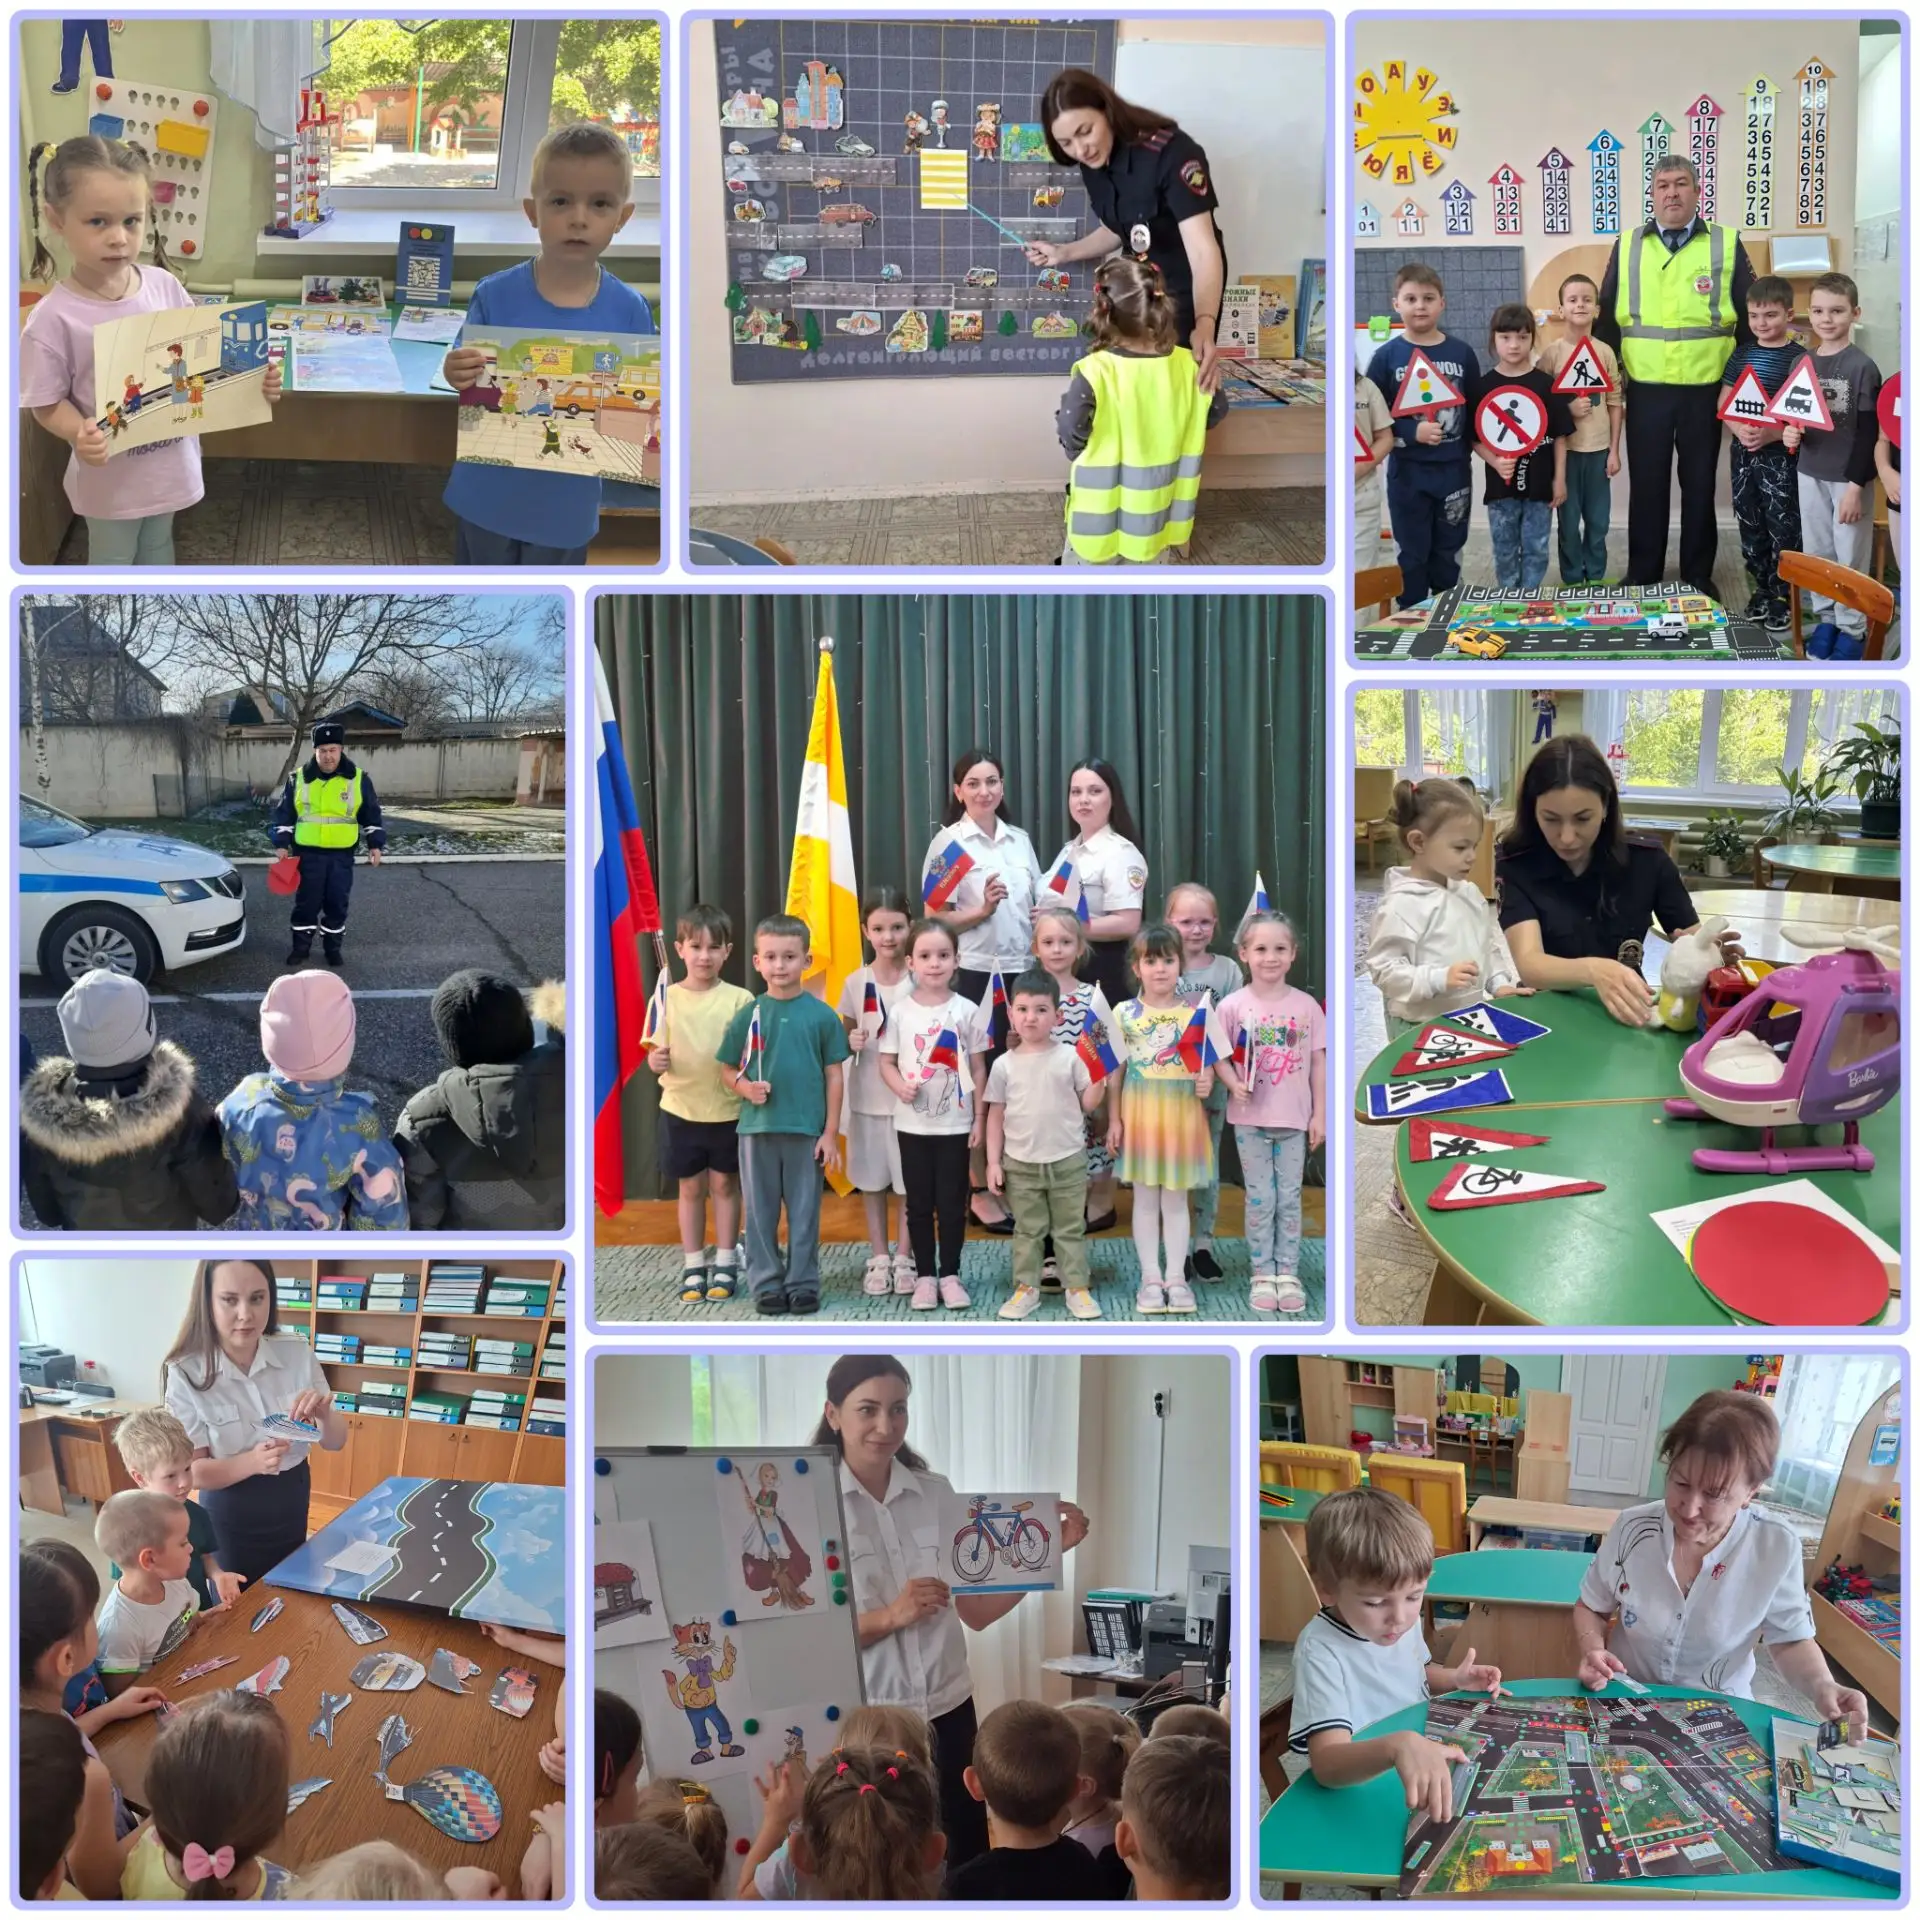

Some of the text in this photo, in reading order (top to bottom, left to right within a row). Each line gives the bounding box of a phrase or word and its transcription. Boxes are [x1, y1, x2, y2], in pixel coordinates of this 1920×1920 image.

[1388, 64, 1401, 79] А
[1807, 65, 1822, 76] 10
[1361, 78, 1375, 93] О
[1417, 74, 1430, 91] У
[1756, 79, 1766, 94] 9
[1438, 97, 1450, 112] Э
[1700, 100, 1710, 115] 8
[1653, 119, 1662, 132] 7
[1438, 128, 1451, 143] И
[1600, 136, 1610, 149] 6
[1363, 153, 1384, 174] Ю
[1422, 151, 1434, 170] Ё
[1551, 154, 1560, 168] 5
[1396, 165, 1408, 180] Я
[1501, 170, 1510, 183] 4
[1453, 186, 1462, 199] 3
[1361, 206, 1369, 217] 1
[1405, 204, 1415, 217] 2
[1223, 288, 1256, 296] РОЖНЫЕ
[1517, 457, 1530, 491] CREATE
[1847, 1067, 1879, 1088] Barbie
